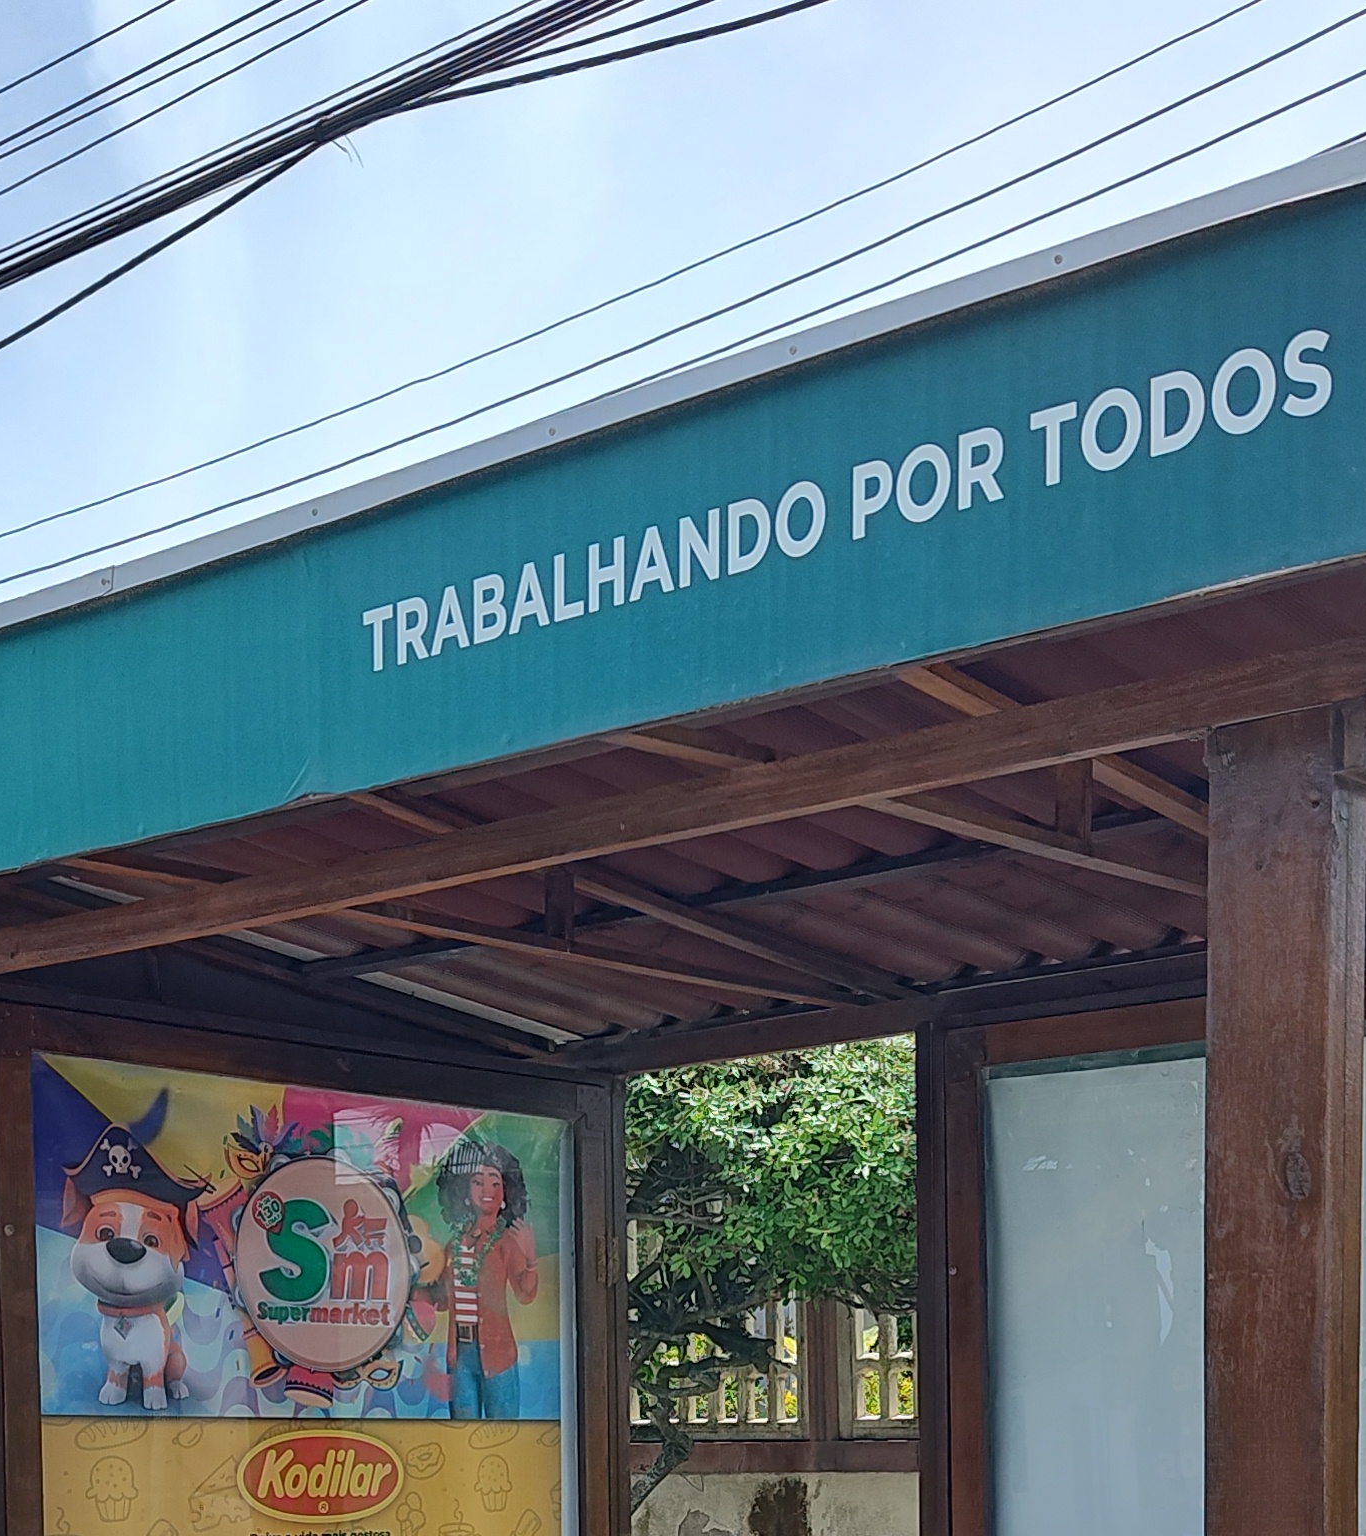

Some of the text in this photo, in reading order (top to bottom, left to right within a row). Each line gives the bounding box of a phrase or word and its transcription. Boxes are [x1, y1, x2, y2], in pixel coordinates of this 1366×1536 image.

[362, 329, 1333, 672] TRABALHANDO POR TODOS
[257, 1200, 280, 1221] 130
[257, 1301, 391, 1326] Supermarket
[257, 1448, 392, 1499] Kodilar
